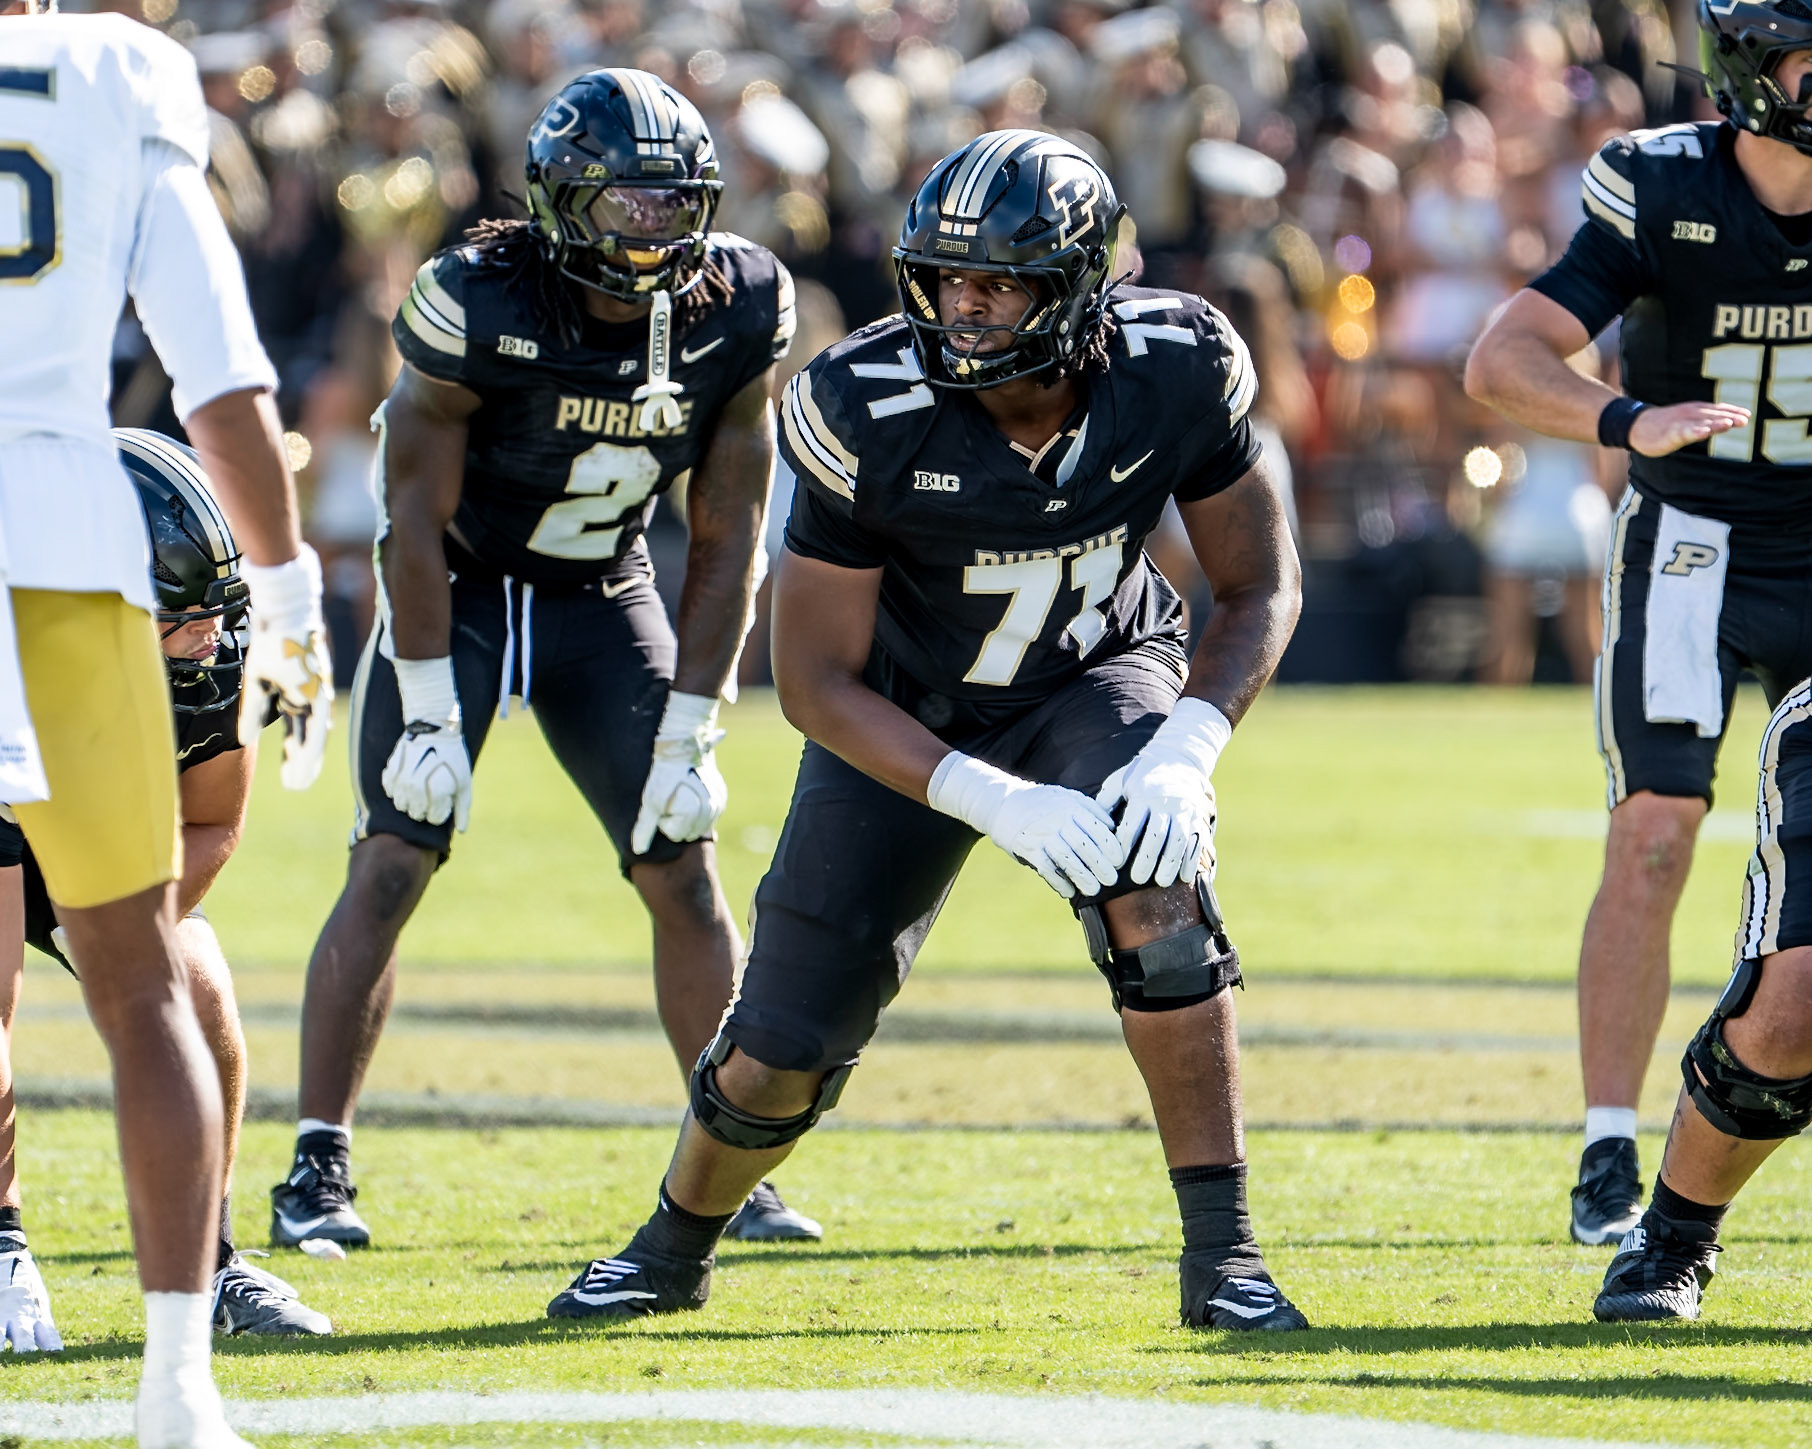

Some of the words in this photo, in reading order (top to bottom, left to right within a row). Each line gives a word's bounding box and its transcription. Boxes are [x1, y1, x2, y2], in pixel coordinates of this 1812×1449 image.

[935, 238, 969, 254] PURDUE
[909, 280, 930, 310] BOILER
[923, 306, 936, 320] UP
[655, 318, 665, 370] BATTLE
[848, 346, 936, 420] 71
[526, 441, 662, 561] 2
[1660, 541, 1719, 577] P
[962, 542, 1123, 687] 71
